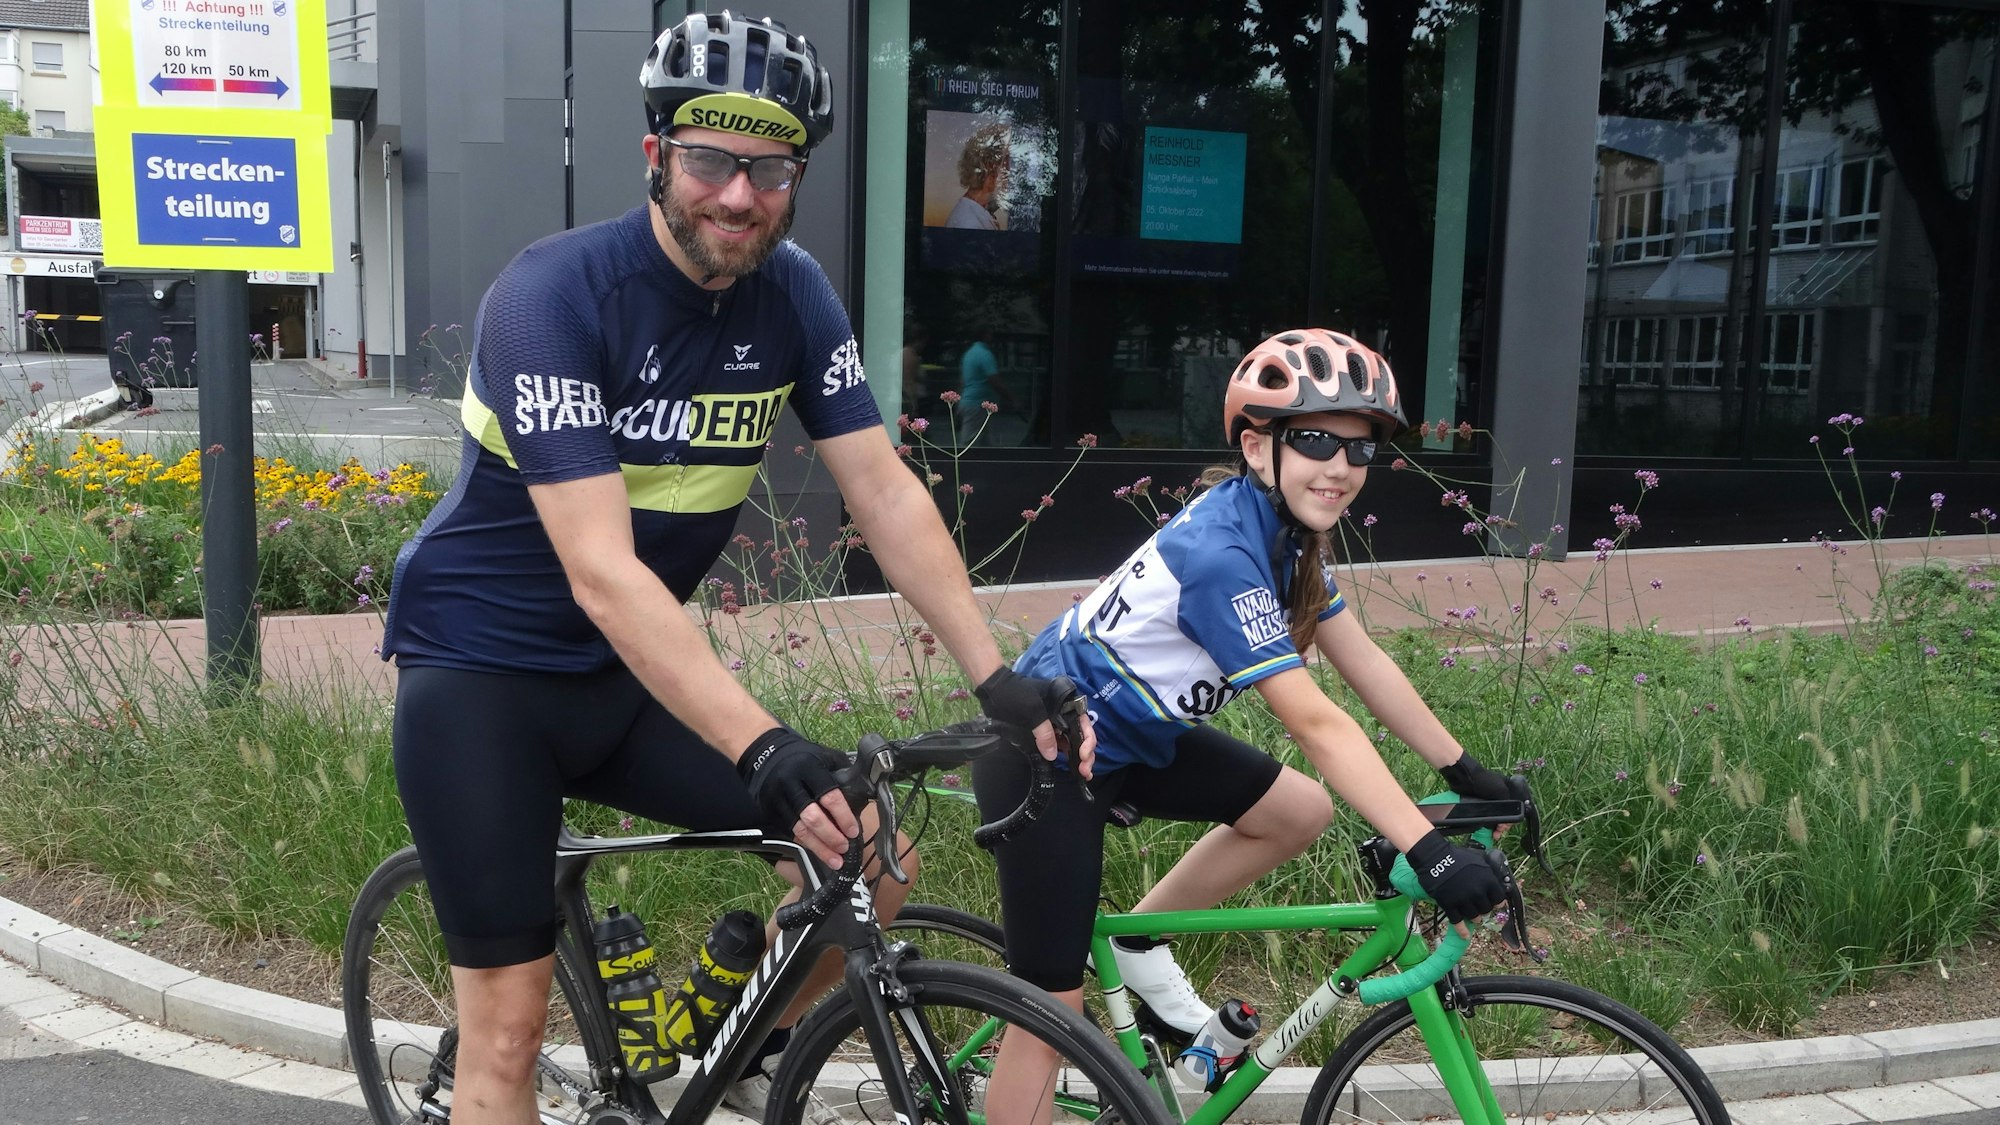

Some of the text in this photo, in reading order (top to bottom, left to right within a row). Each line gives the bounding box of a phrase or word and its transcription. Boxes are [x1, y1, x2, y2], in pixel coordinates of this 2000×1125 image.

[186, 0, 245, 16] Achtung
[159, 17, 270, 36] Streckenteilung
[164, 45, 207, 58] 80 km
[162, 62, 212, 76] 120 km
[228, 65, 270, 78] 50 km
[948, 79, 1040, 100] RHEIN SIEG FORUM
[690, 108, 800, 141] SCUDERIA
[1150, 135, 1204, 150] REINHOLD
[146, 156, 286, 184] Strecken-
[1148, 153, 1201, 168] MESSNER
[165, 194, 270, 225] teilung
[1158, 206, 1186, 216] Oktober
[1187, 208, 1204, 217] 2022
[25, 219, 68, 228] PARKZENTRUM
[724, 362, 760, 370] CUORE
[514, 373, 602, 408] SUED
[610, 394, 782, 442] SCUDERIA
[752, 744, 777, 772] GORE
[1430, 854, 1456, 878] GORE
[1020, 996, 1072, 1032] CONTINENTAL
[1274, 1000, 1323, 1055] Intec
